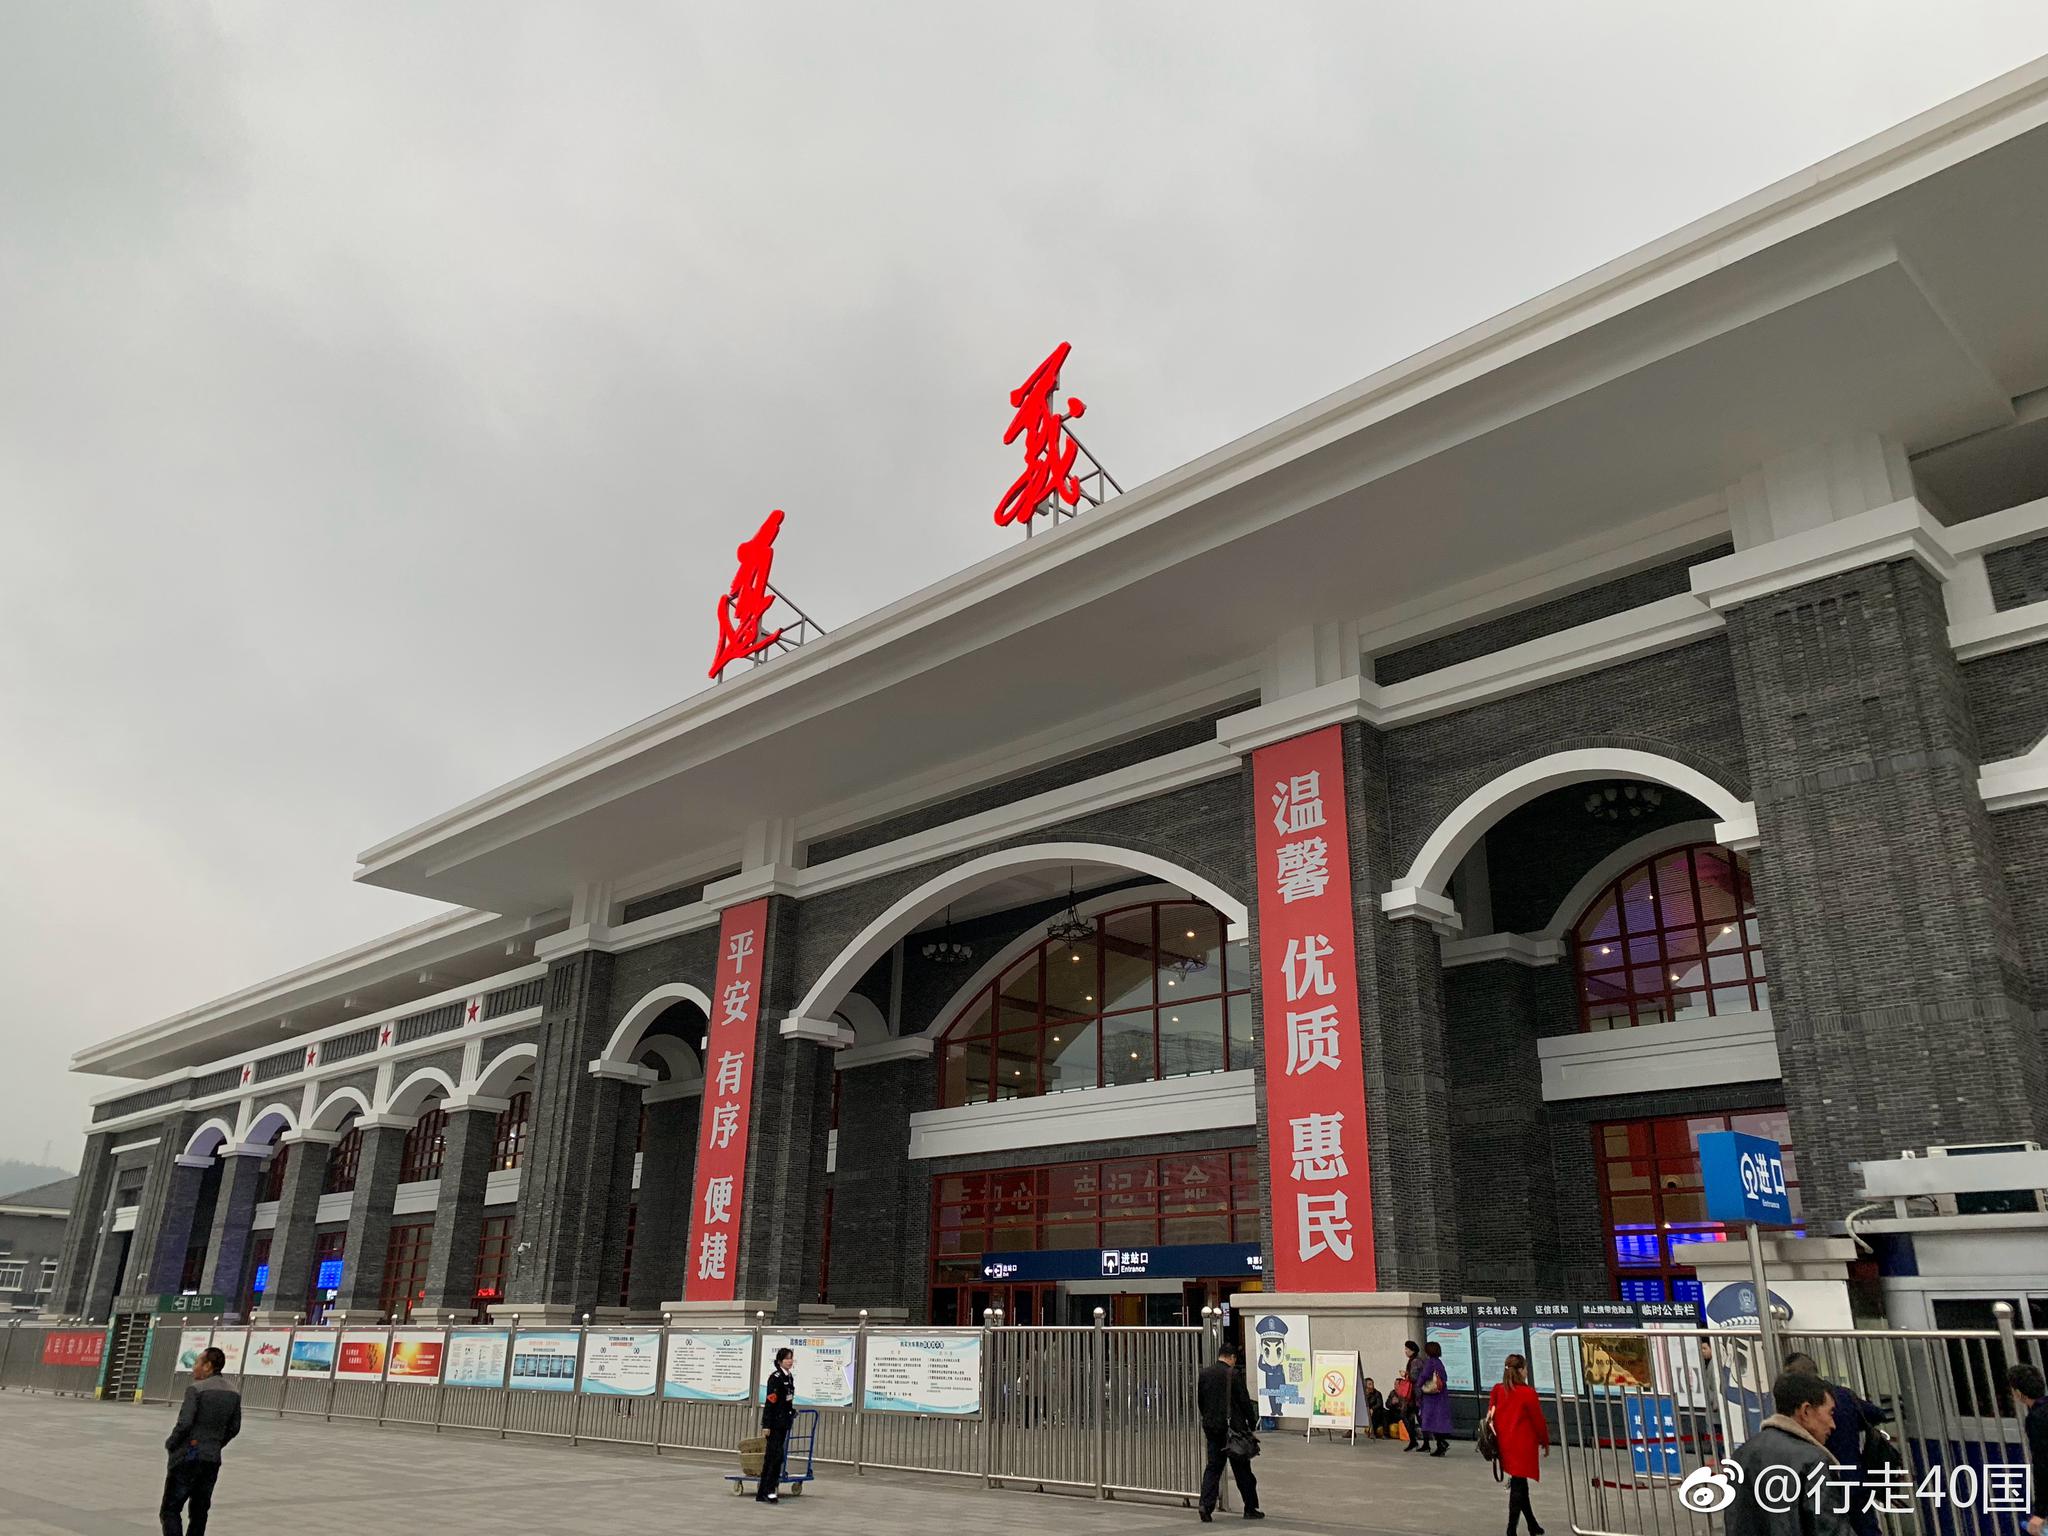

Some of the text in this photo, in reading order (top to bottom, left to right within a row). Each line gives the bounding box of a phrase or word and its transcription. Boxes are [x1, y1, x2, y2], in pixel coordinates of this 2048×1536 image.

[1272, 770, 1354, 1262] 温馨 优质 惠民
[698, 930, 754, 1280] 平安 有序 便捷
[1754, 1152, 1787, 1198] 进口
[1074, 1164, 1210, 1208] 牢记使命
[1121, 1251, 1149, 1265] 进站口
[1121, 1265, 1146, 1273] Entrance
[191, 1296, 213, 1307] 出口
[1425, 1305, 1468, 1315] 铁路安检须知
[1477, 1306, 1518, 1316] 实名制公告
[1535, 1305, 1569, 1315] 征信须知
[1582, 1305, 1634, 1315] 禁止携带危险品
[1641, 1304, 1696, 1316] 临时公告栏
